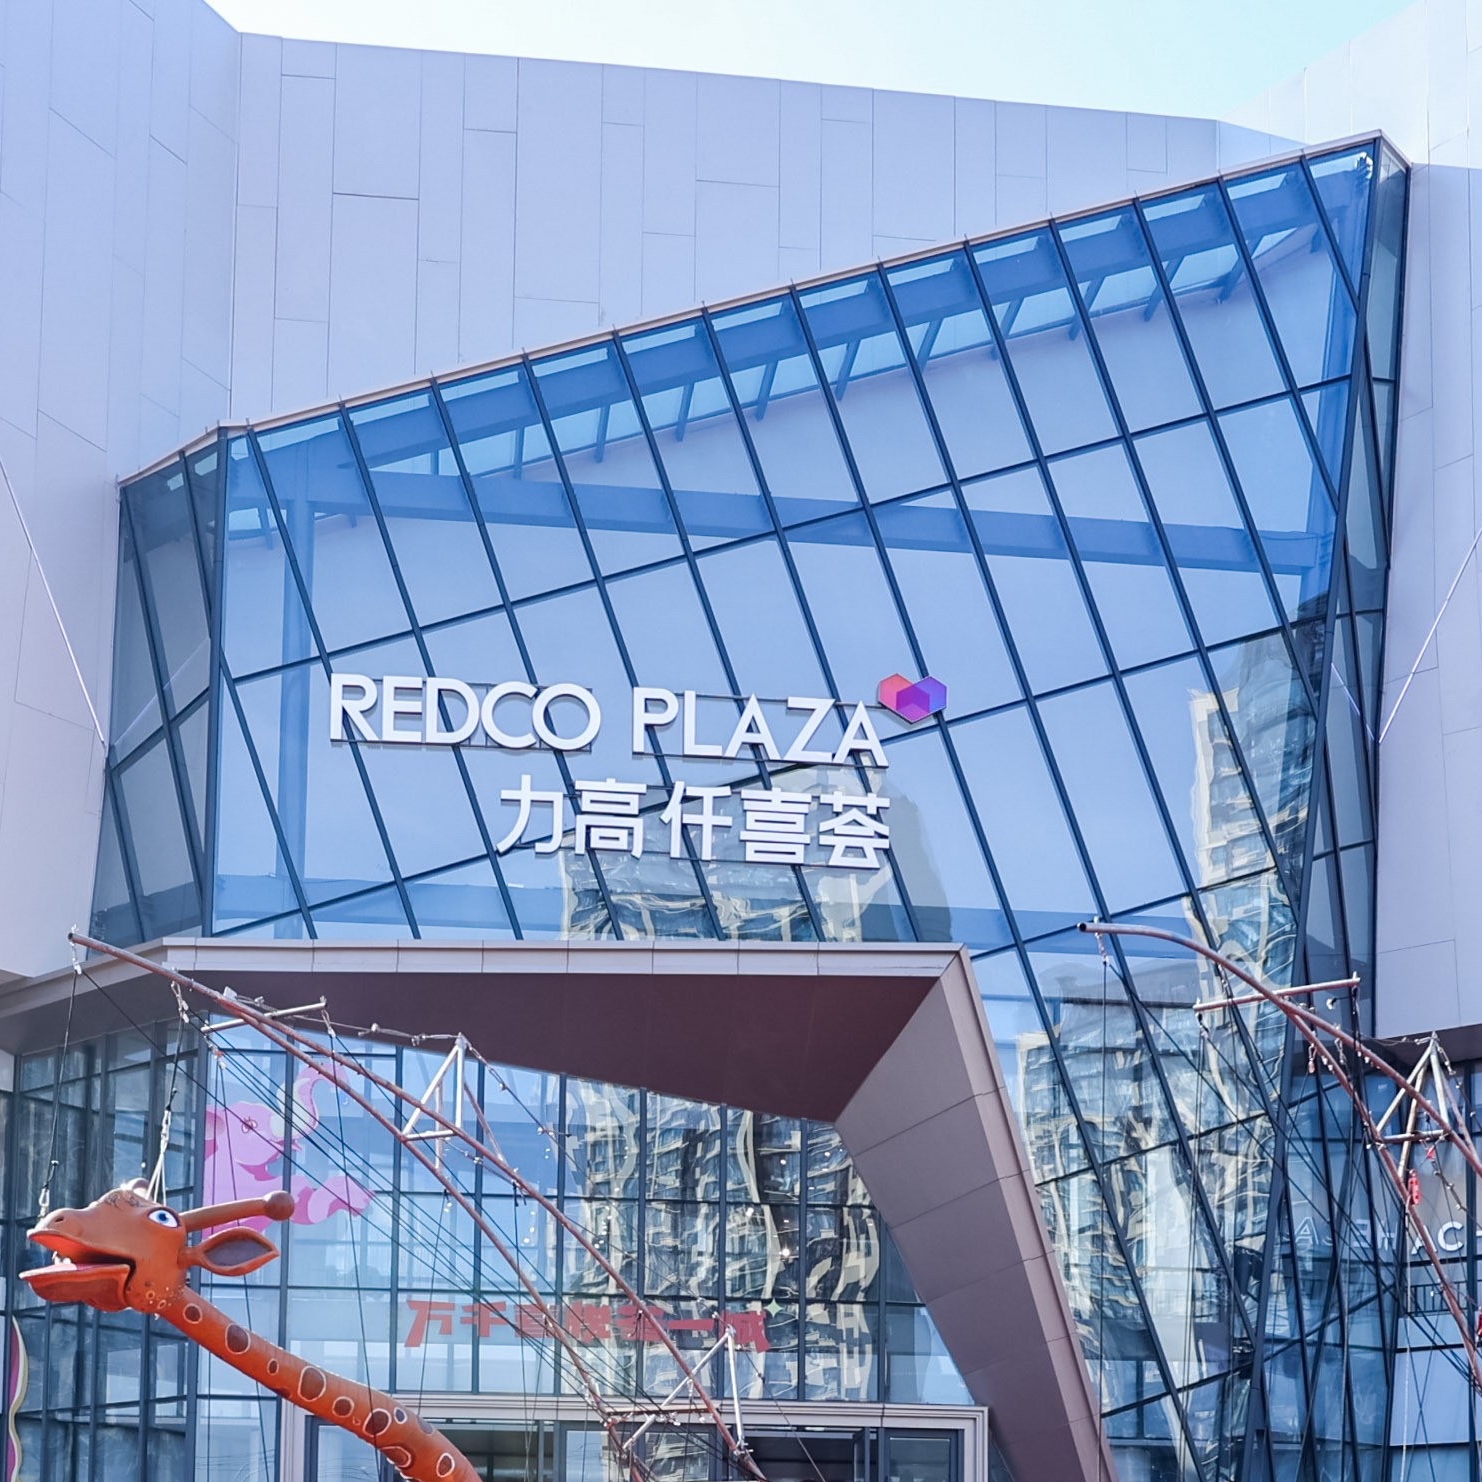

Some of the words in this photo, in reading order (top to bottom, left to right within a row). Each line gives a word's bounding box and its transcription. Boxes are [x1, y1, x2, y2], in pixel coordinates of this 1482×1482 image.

[330, 672, 602, 752] REDCO
[631, 686, 889, 768] PLAZA
[496, 774, 891, 870] 力高仟喜荟
